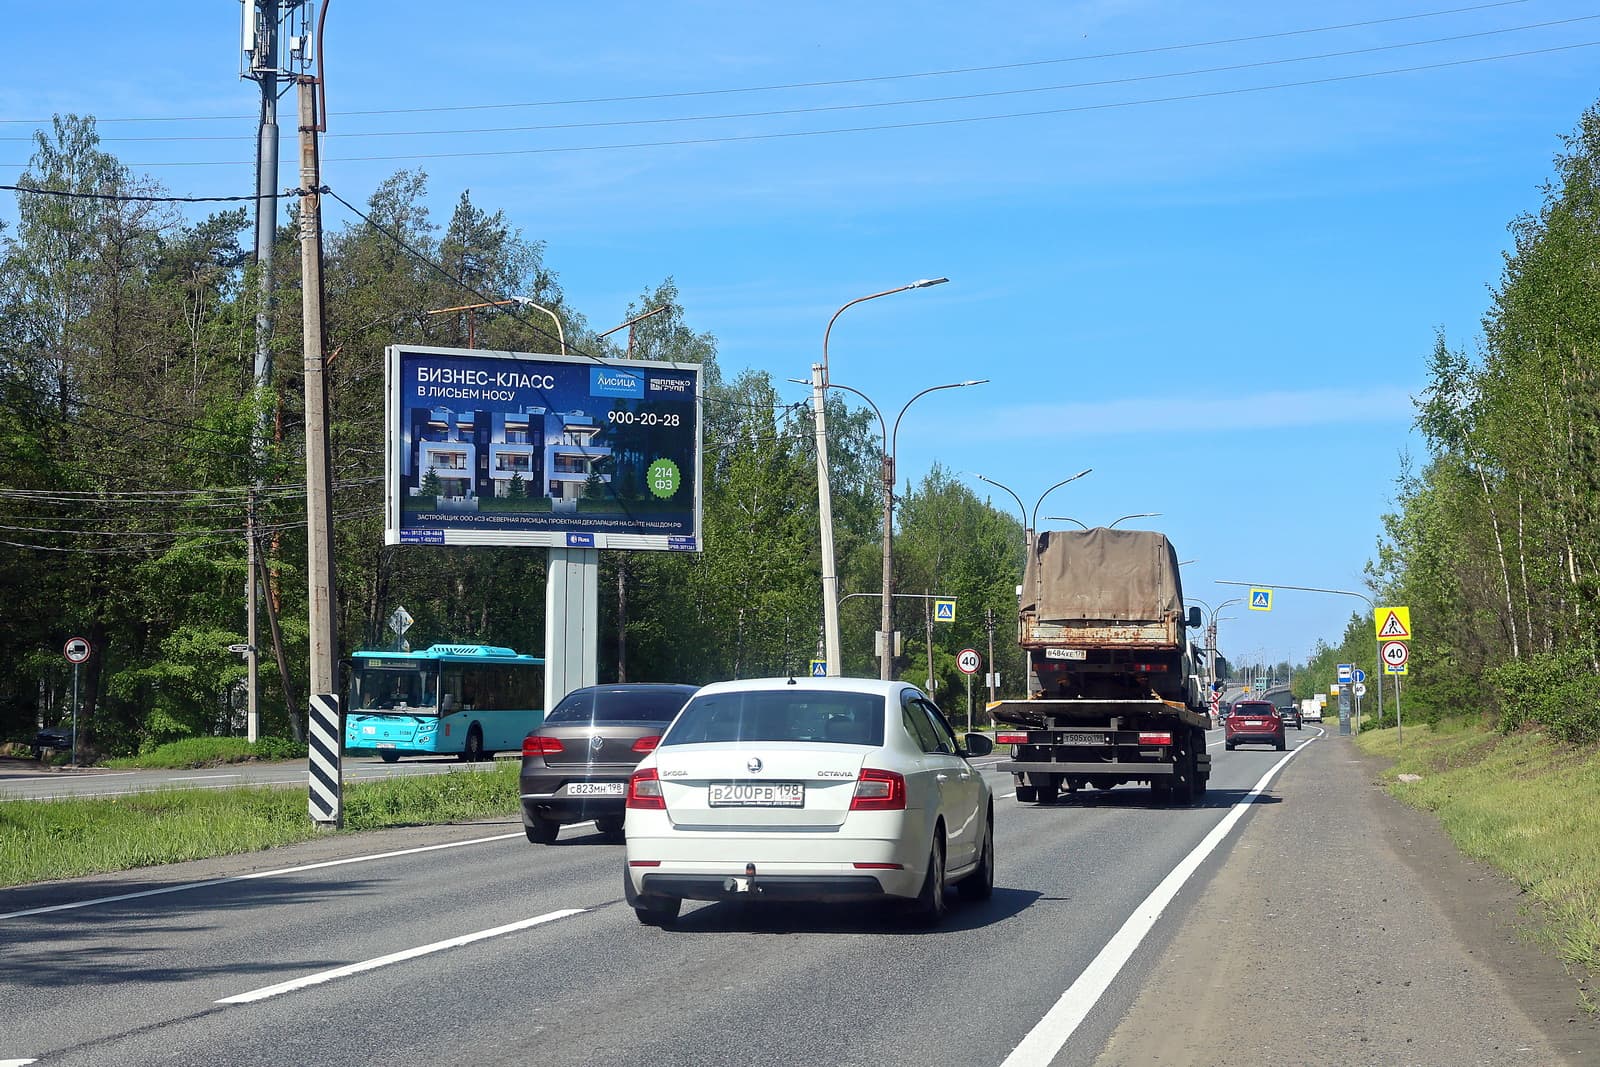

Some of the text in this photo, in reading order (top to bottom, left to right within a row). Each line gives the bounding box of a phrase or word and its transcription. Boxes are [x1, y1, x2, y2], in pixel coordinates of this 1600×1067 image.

[417, 367, 555, 389] БИЗНЕС-КЛАСС
[417, 386, 515, 401] В ЛИСЬЕМ НОСУ
[607, 411, 680, 427] 900-20-28
[655, 467, 672, 478] 214
[655, 479, 672, 490] ФЗ
[417, 513, 459, 521] ЗАСТРОЙЩИК
[1388, 648, 1403, 659] 40
[962, 656, 976, 666] 40
[777, 783, 799, 796] 198
